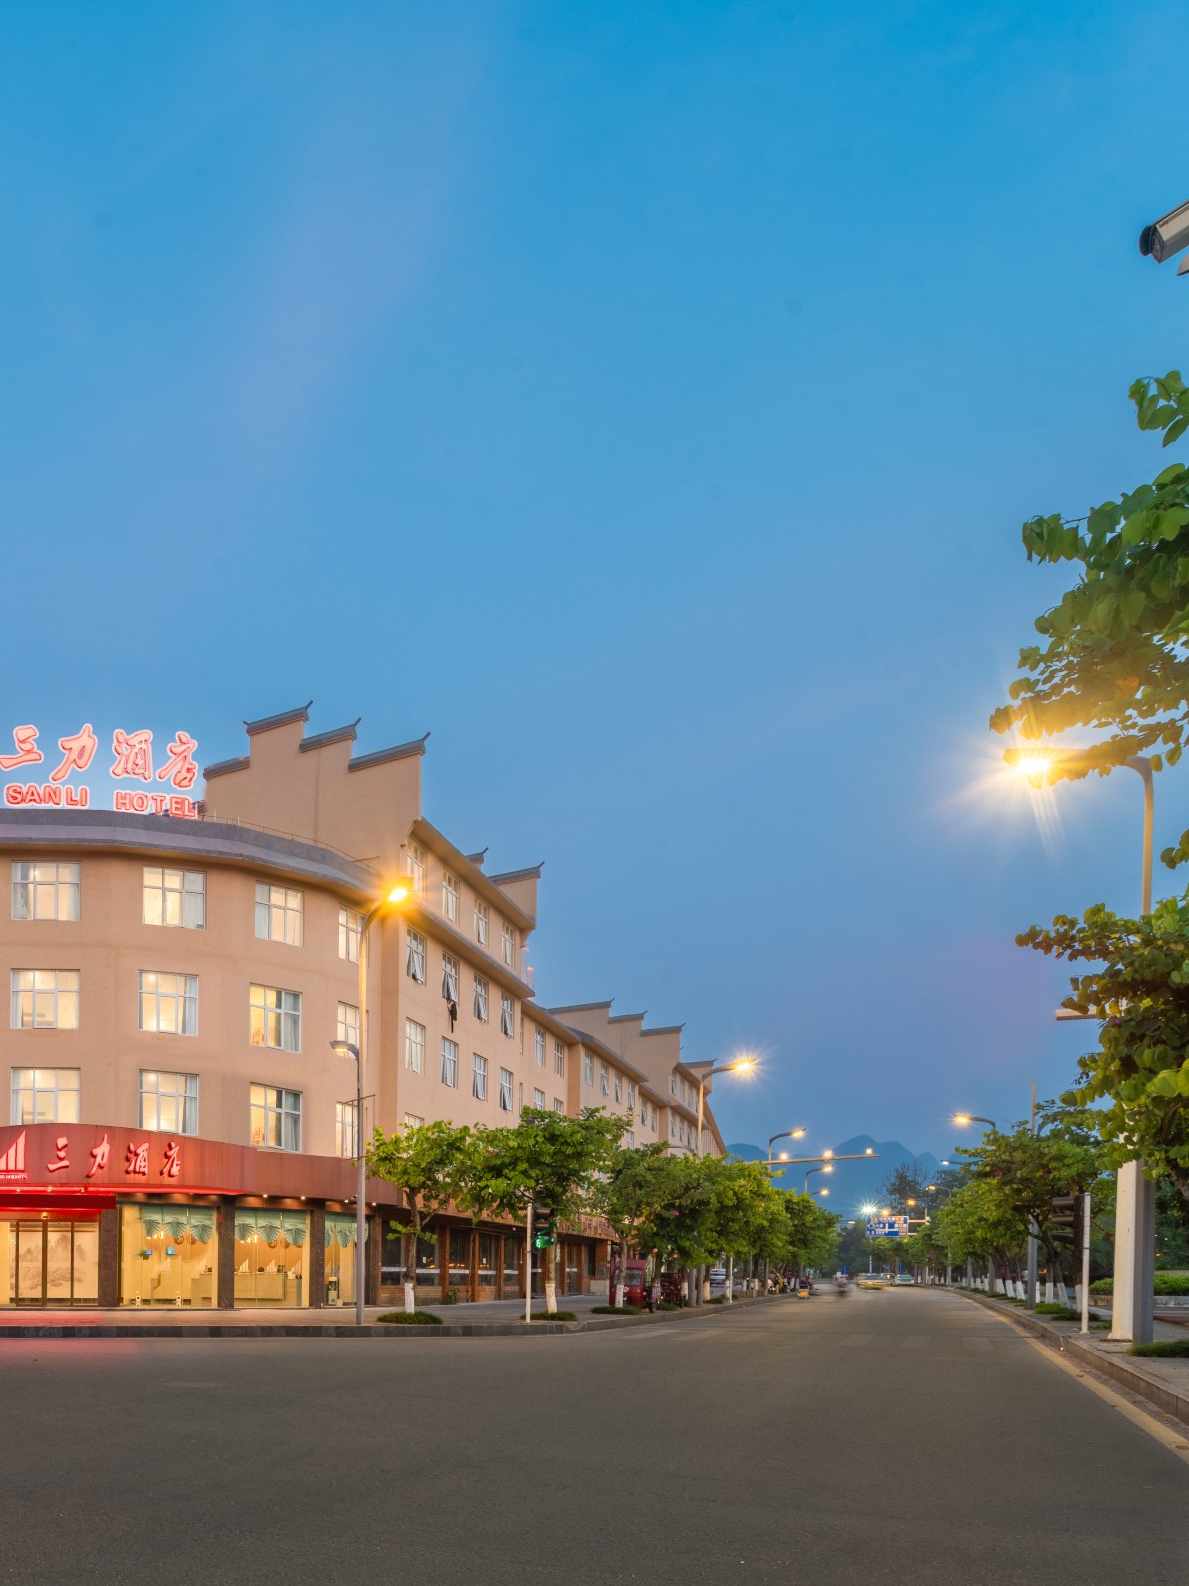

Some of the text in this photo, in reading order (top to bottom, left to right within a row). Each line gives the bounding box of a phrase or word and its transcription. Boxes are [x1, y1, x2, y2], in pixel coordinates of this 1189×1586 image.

[6, 785, 197, 819] SANLI HOTEL
[47, 1134, 181, 1178] 三力酒店
